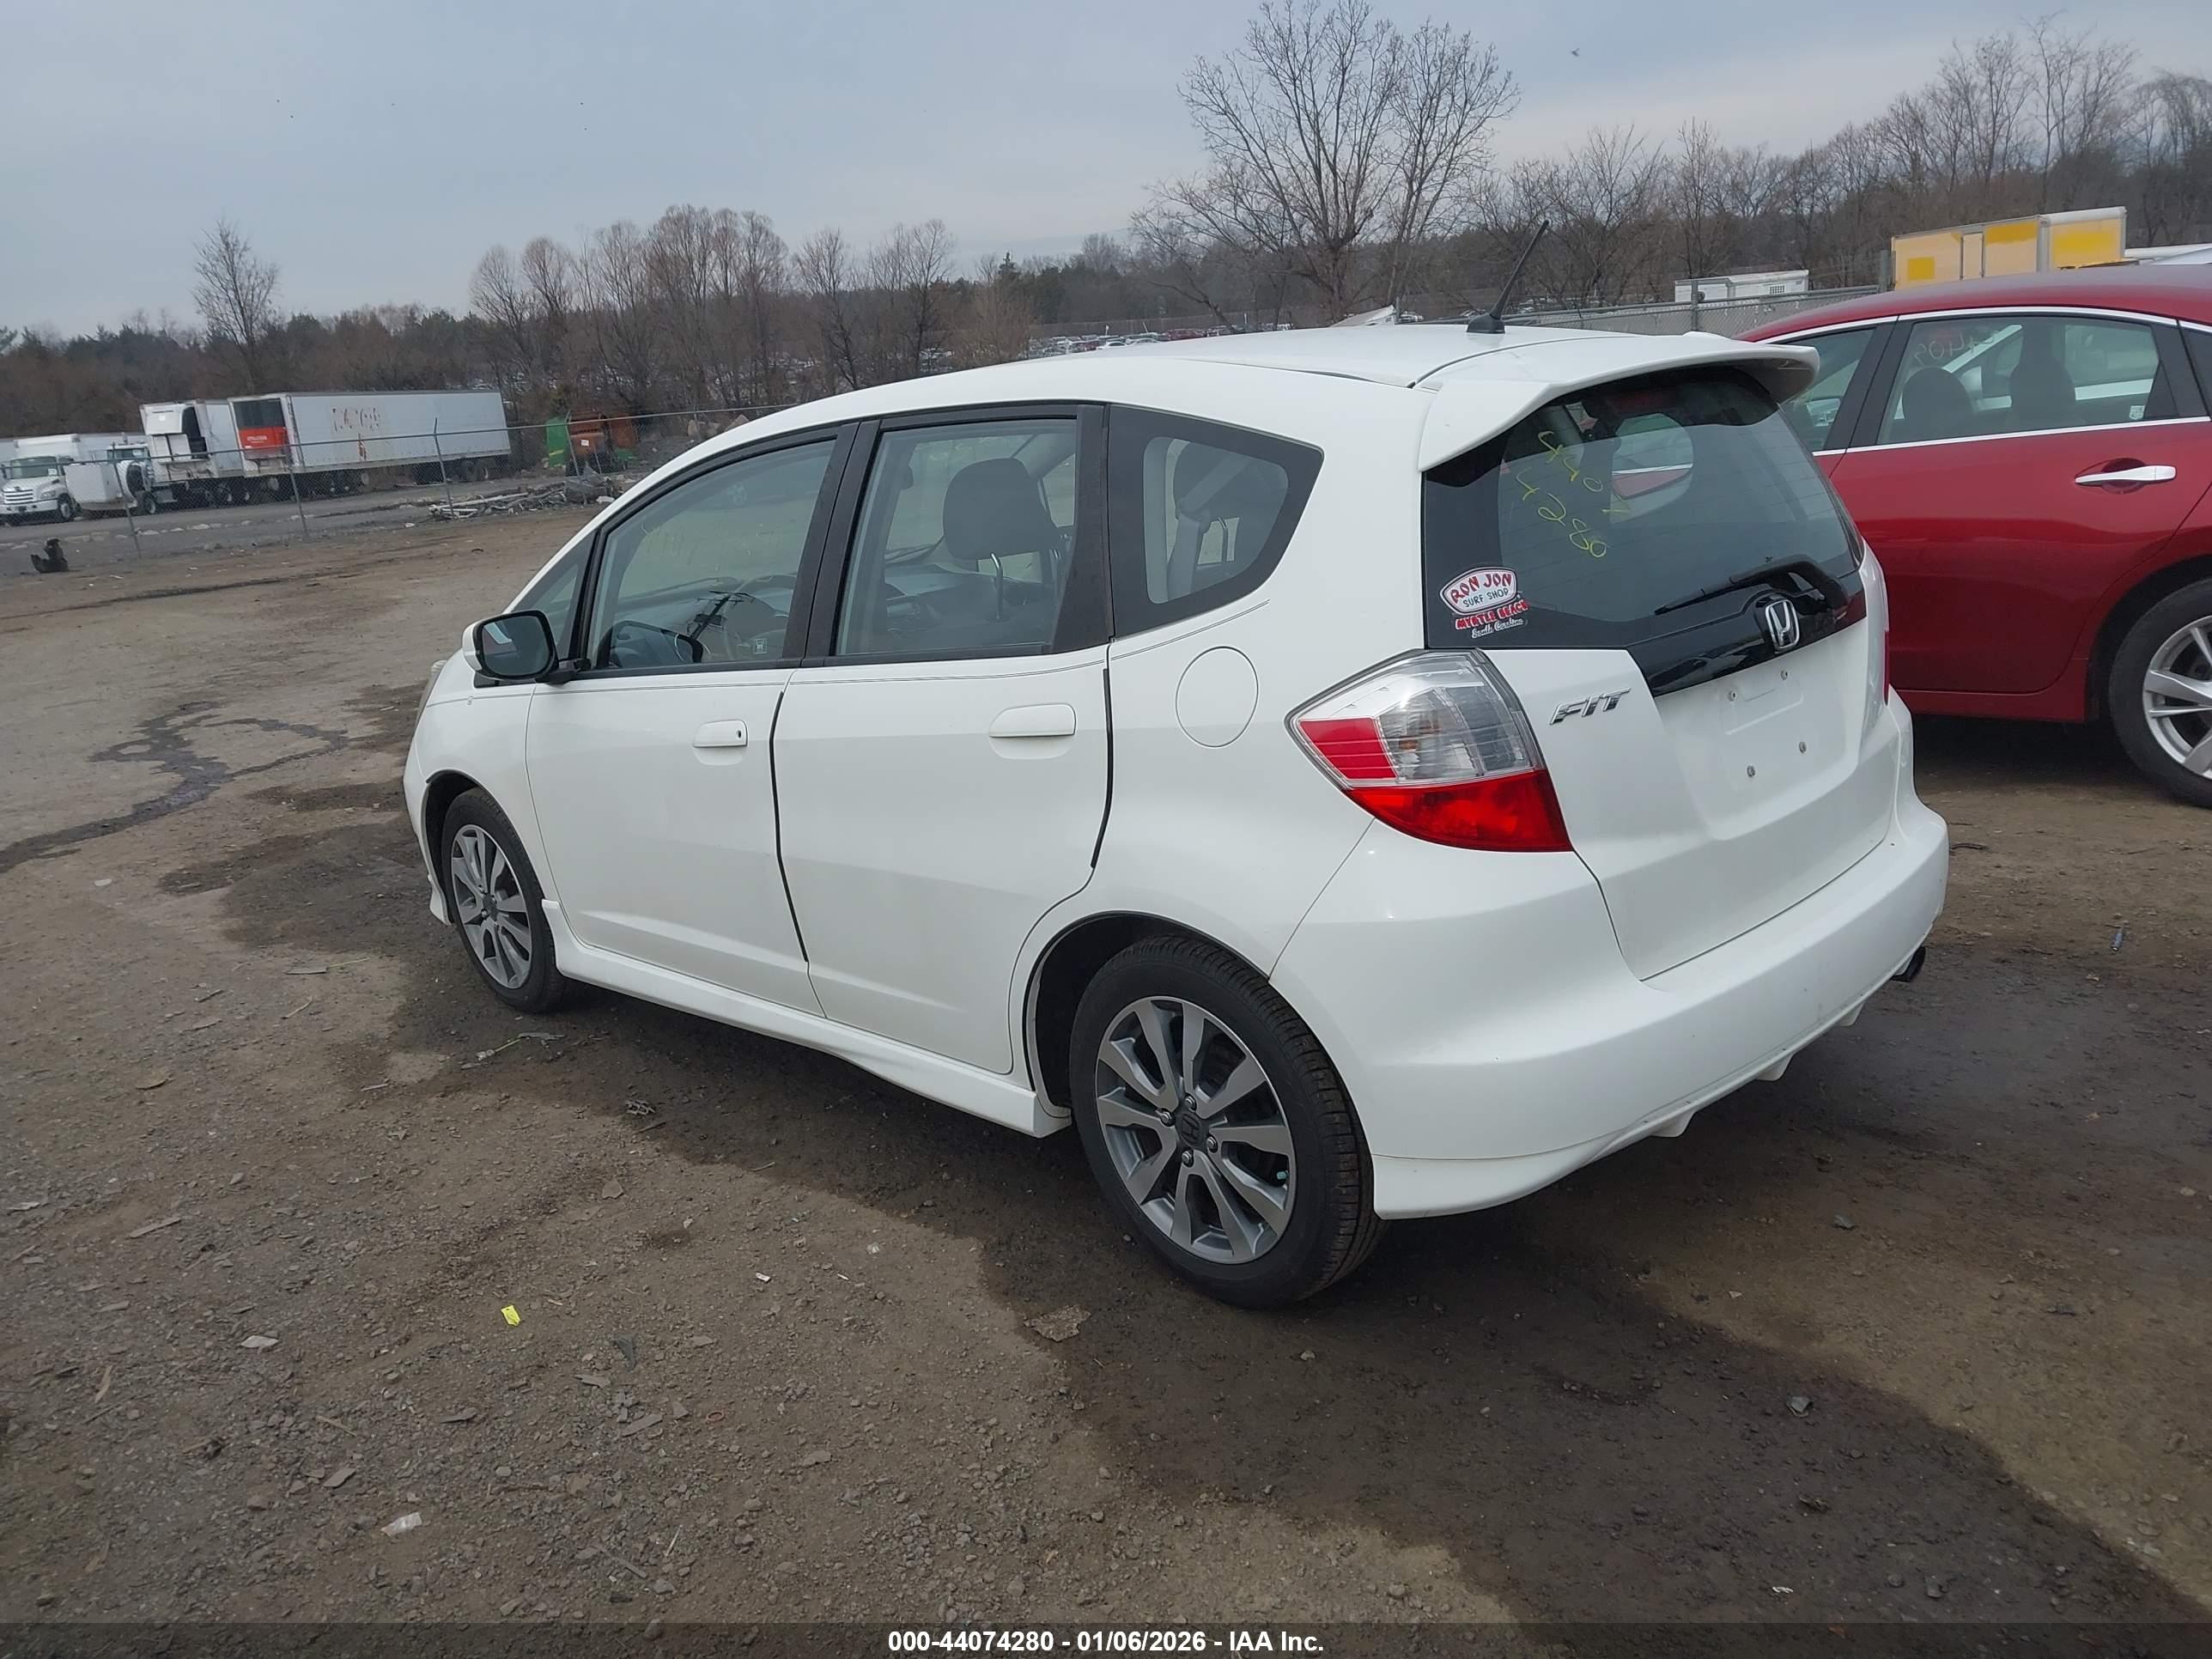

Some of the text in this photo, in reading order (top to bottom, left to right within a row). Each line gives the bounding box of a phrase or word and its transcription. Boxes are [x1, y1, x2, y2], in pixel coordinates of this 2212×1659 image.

[1516, 467, 1610, 558] 4280
[1450, 573, 1512, 604] RON JON
[1462, 587, 1509, 608] SURF SHOP
[1455, 599, 1529, 629] MYRTLE BEACH
[1549, 687, 1631, 725] FIT
